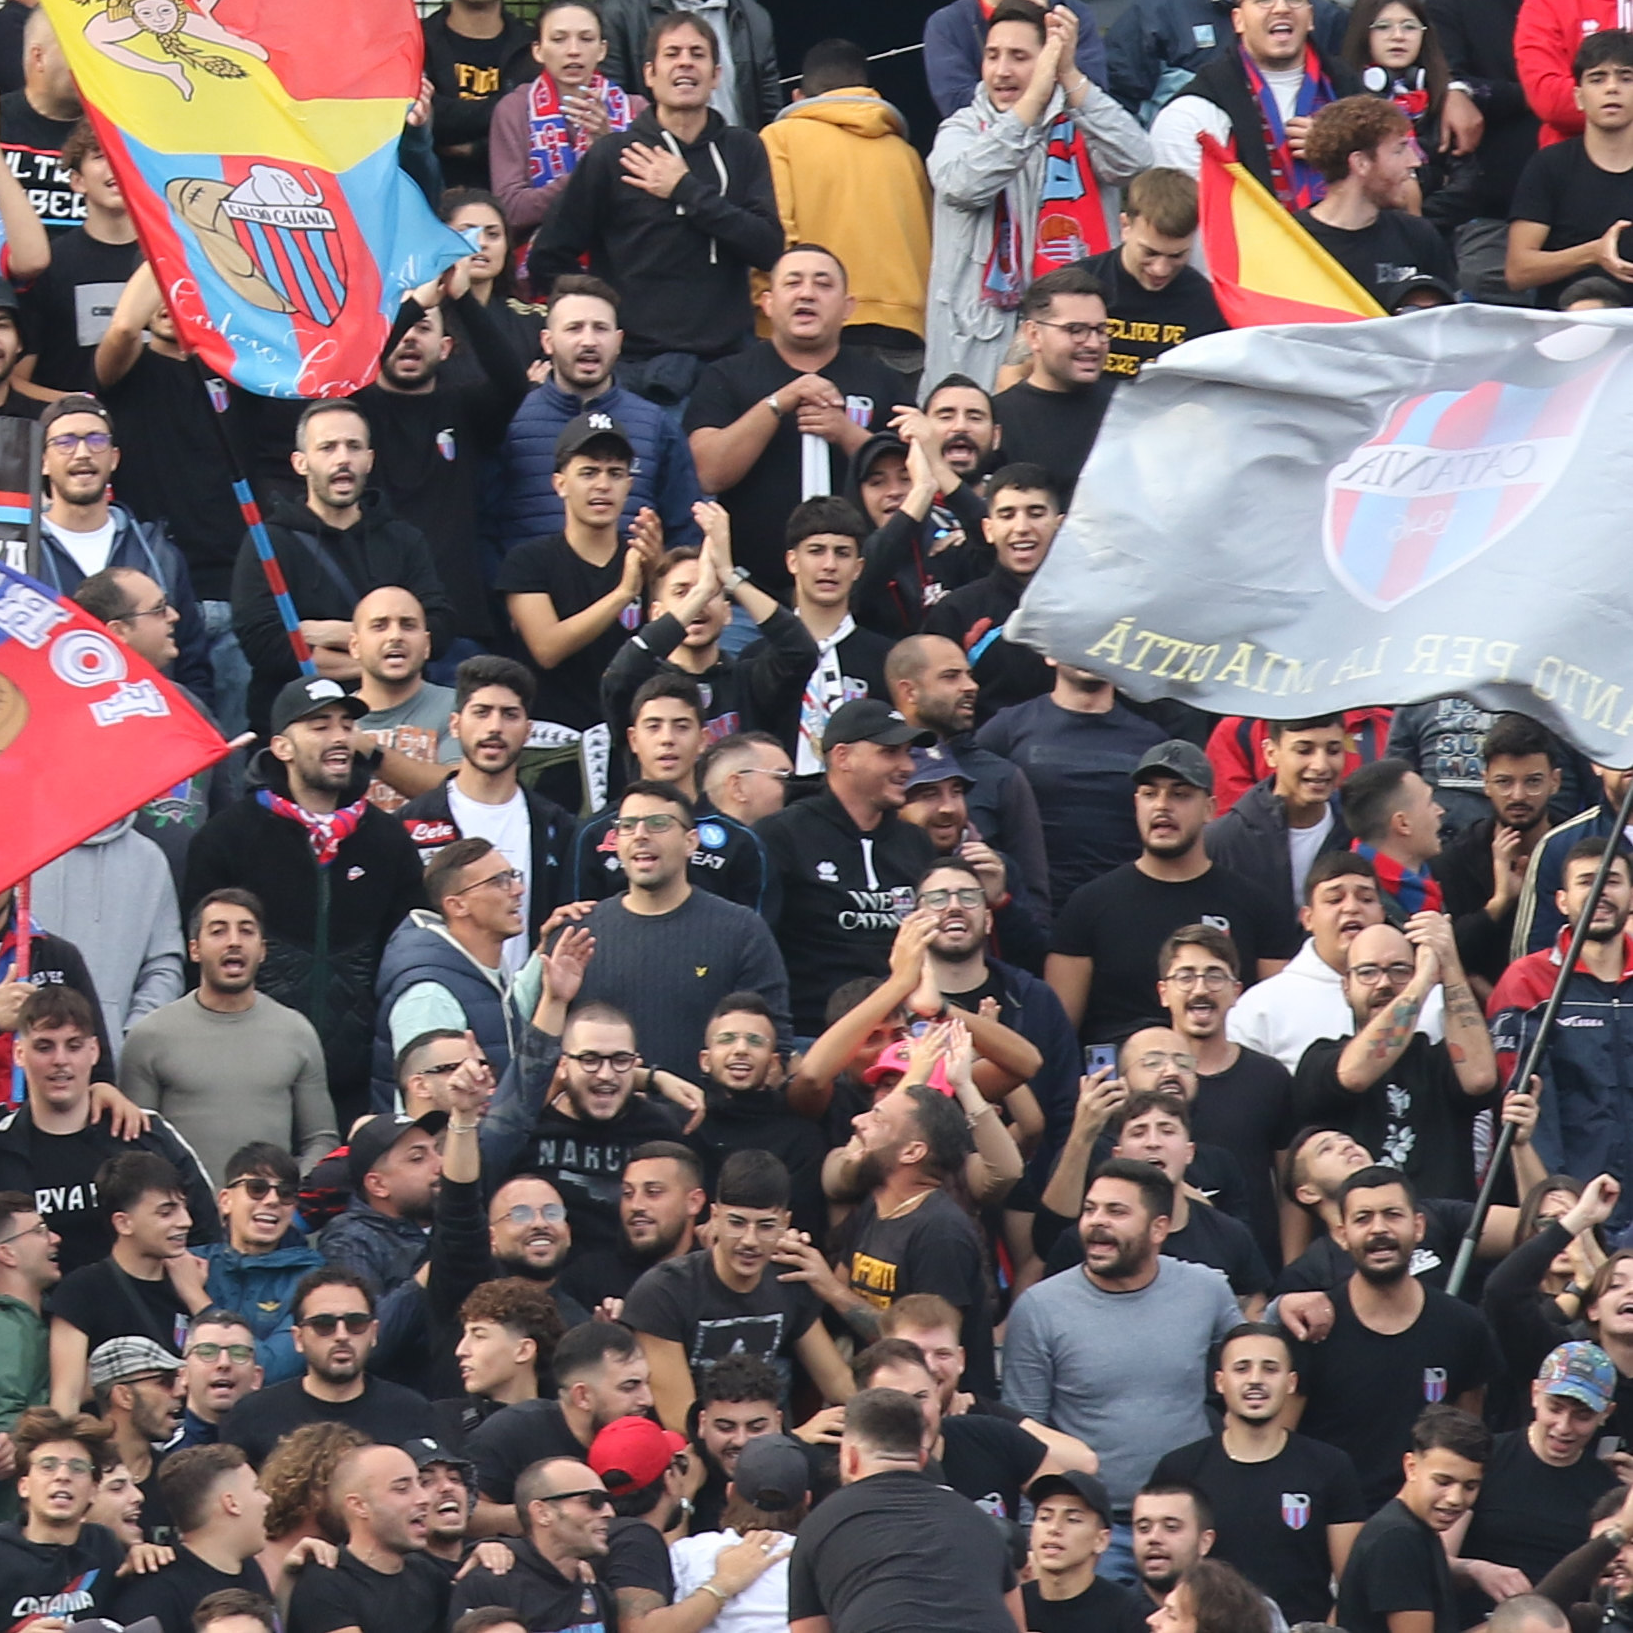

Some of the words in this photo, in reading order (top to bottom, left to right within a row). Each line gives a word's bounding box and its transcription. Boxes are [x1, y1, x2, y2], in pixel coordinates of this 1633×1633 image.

[228, 204, 271, 224] CALCIO
[273, 208, 331, 227] CATANIA
[838, 910, 906, 930] CATAN
[35, 1186, 85, 1215] RVA
[12, 1590, 96, 1617] CATANIA
